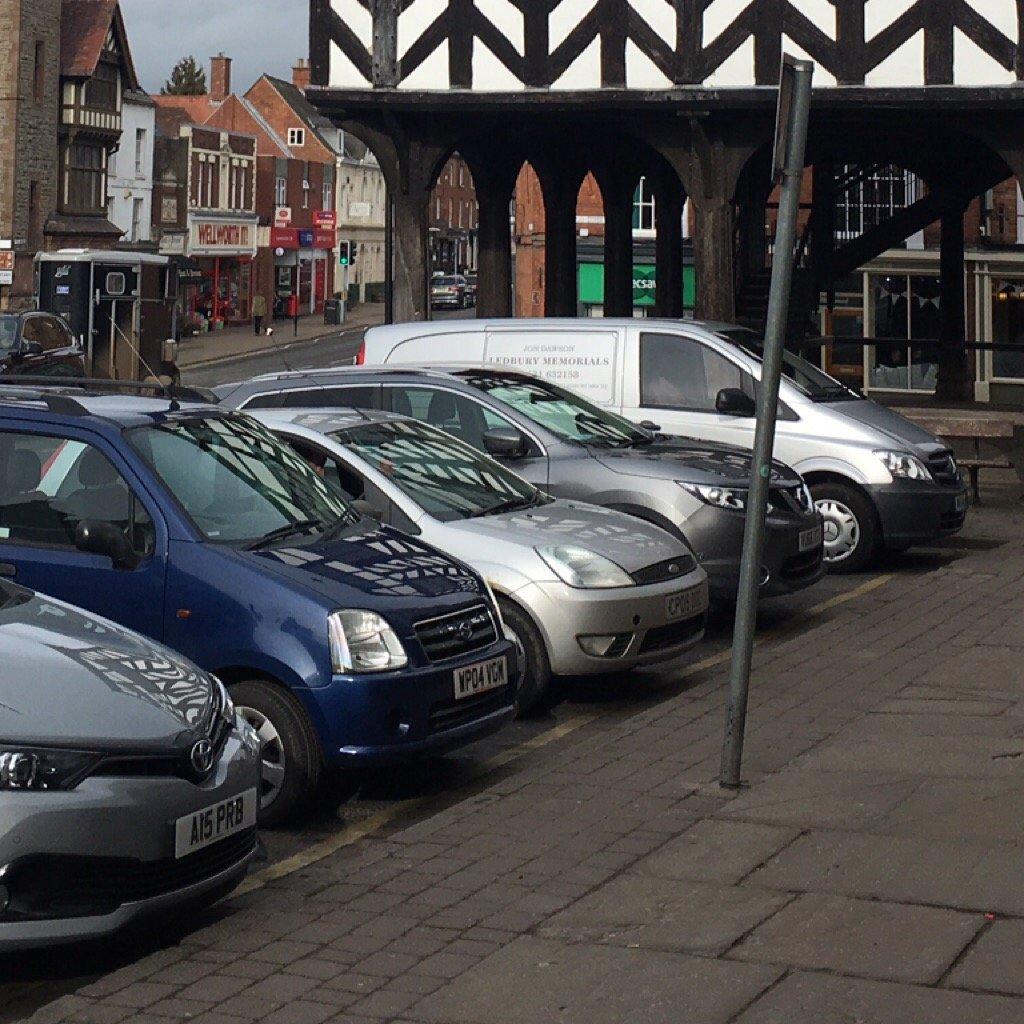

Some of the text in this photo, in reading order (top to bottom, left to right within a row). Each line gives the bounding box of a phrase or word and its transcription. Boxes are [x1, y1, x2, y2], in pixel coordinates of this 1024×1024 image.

[489, 356, 609, 365] LEDBURY MEMORIALS
[459, 666, 484, 692] WP04
[191, 797, 244, 846] A15 PRB
